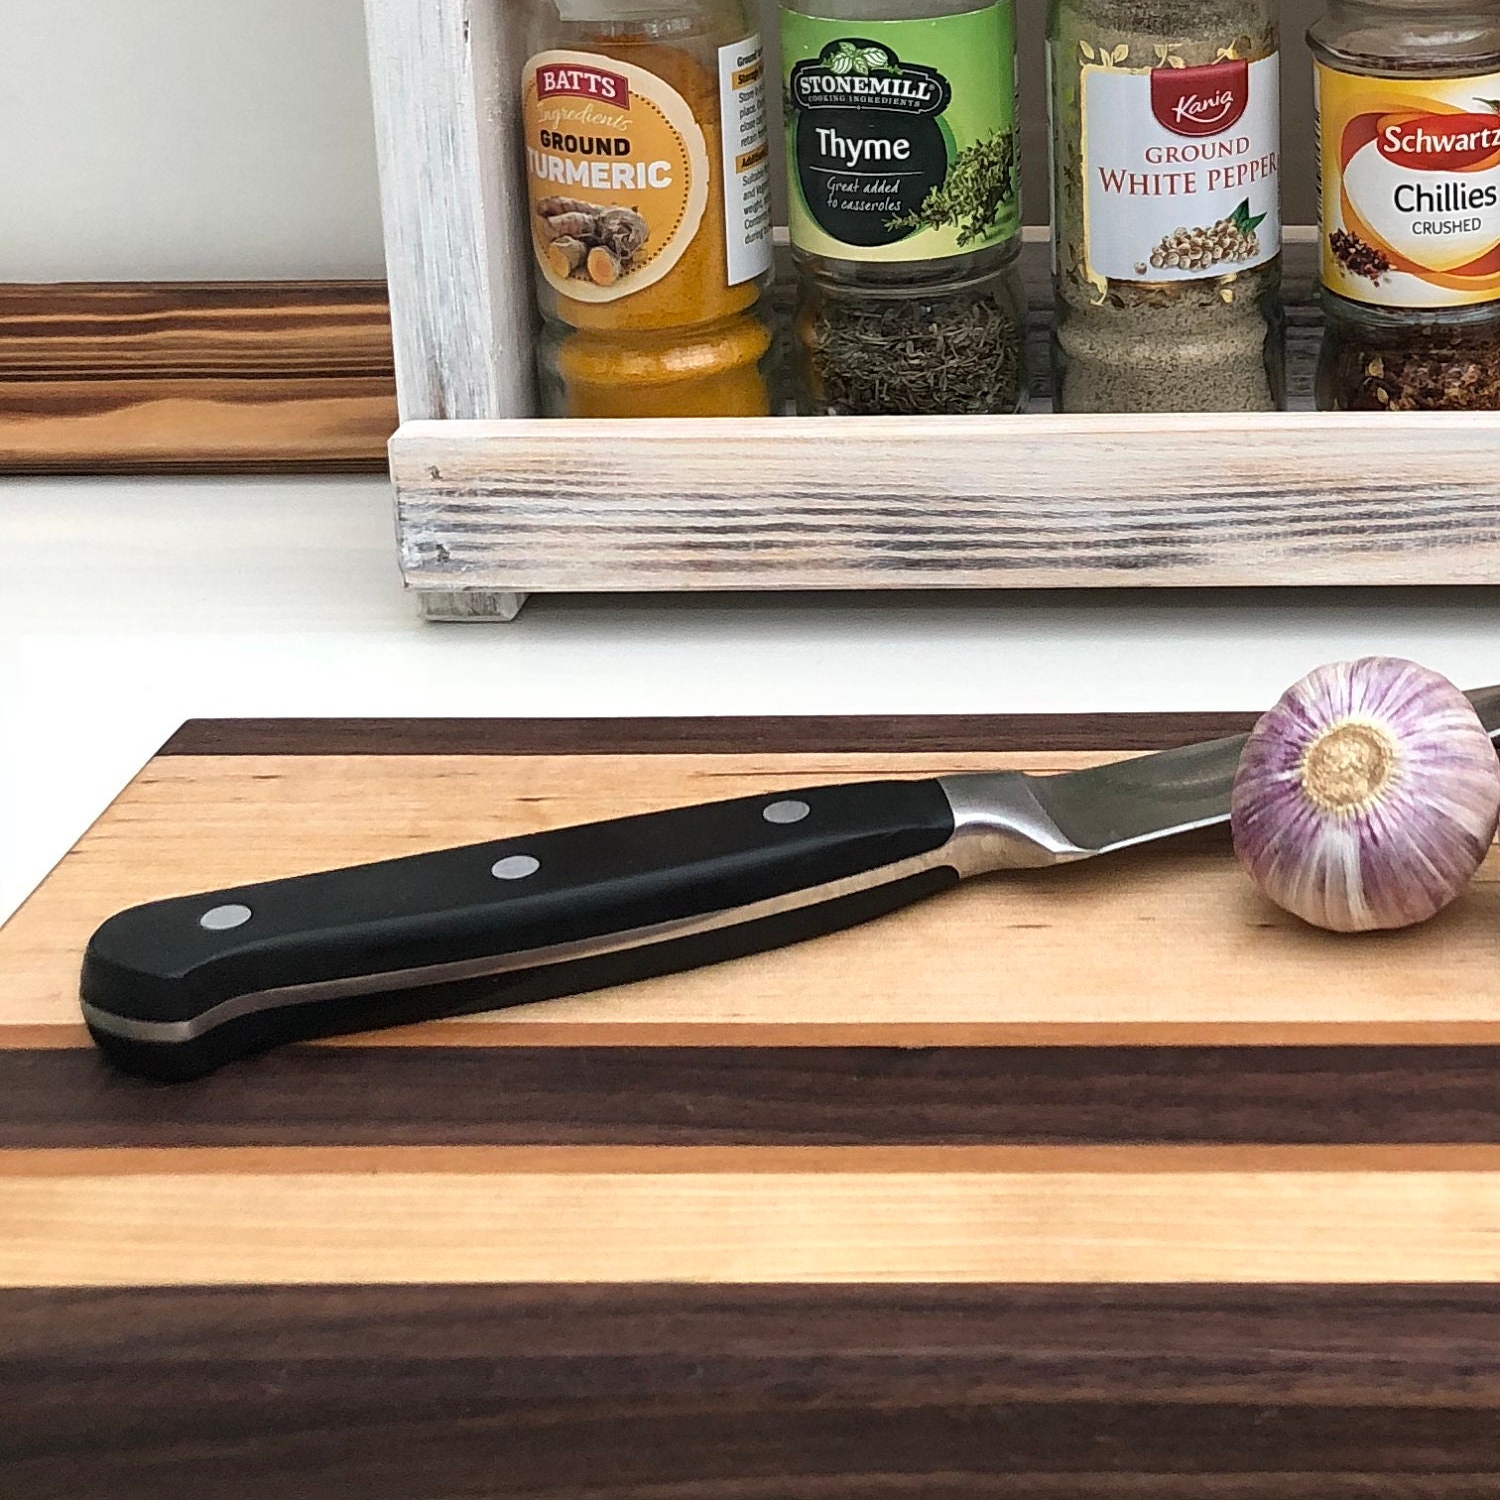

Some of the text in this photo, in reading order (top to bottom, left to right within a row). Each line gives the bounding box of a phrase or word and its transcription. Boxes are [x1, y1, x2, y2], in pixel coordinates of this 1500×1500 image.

[543, 69, 617, 99] BATTS
[799, 74, 932, 102] STONEMILL
[807, 94, 921, 108] COOKING INGREDIENTS
[1171, 89, 1234, 124] Kania
[540, 129, 631, 157] GROUND
[815, 126, 911, 168] Thyme
[1145, 136, 1250, 165] GROUND
[826, 176, 900, 199] Great added
[1099, 152, 1277, 197] WHITE PEPPER
[826, 194, 902, 213] to casseroles
[1393, 181, 1498, 213] Chillies
[1411, 217, 1482, 236] CRUSHED
